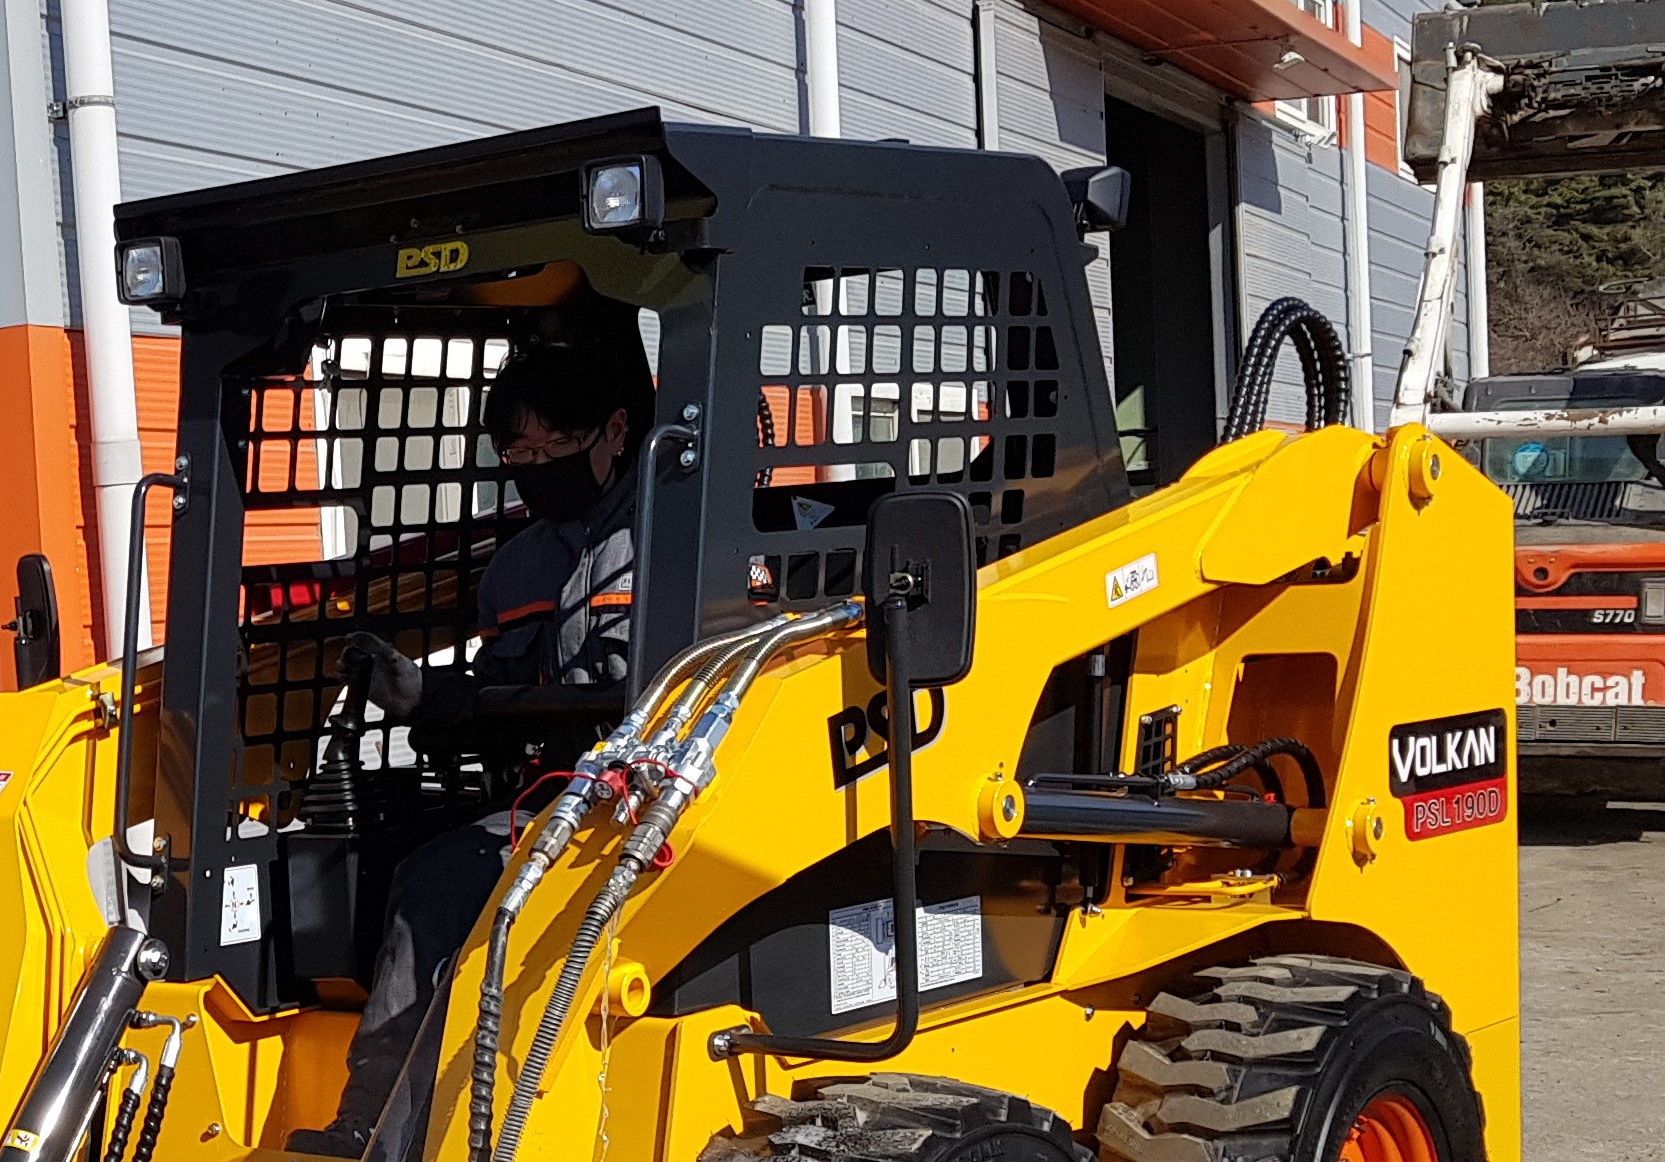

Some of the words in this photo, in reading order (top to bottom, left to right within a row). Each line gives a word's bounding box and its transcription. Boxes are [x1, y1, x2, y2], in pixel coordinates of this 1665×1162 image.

[396, 241, 469, 278] PSD
[1592, 609, 1635, 623] S770
[1515, 666, 1645, 705] Bobcat
[1392, 726, 1496, 783] VOLKAN
